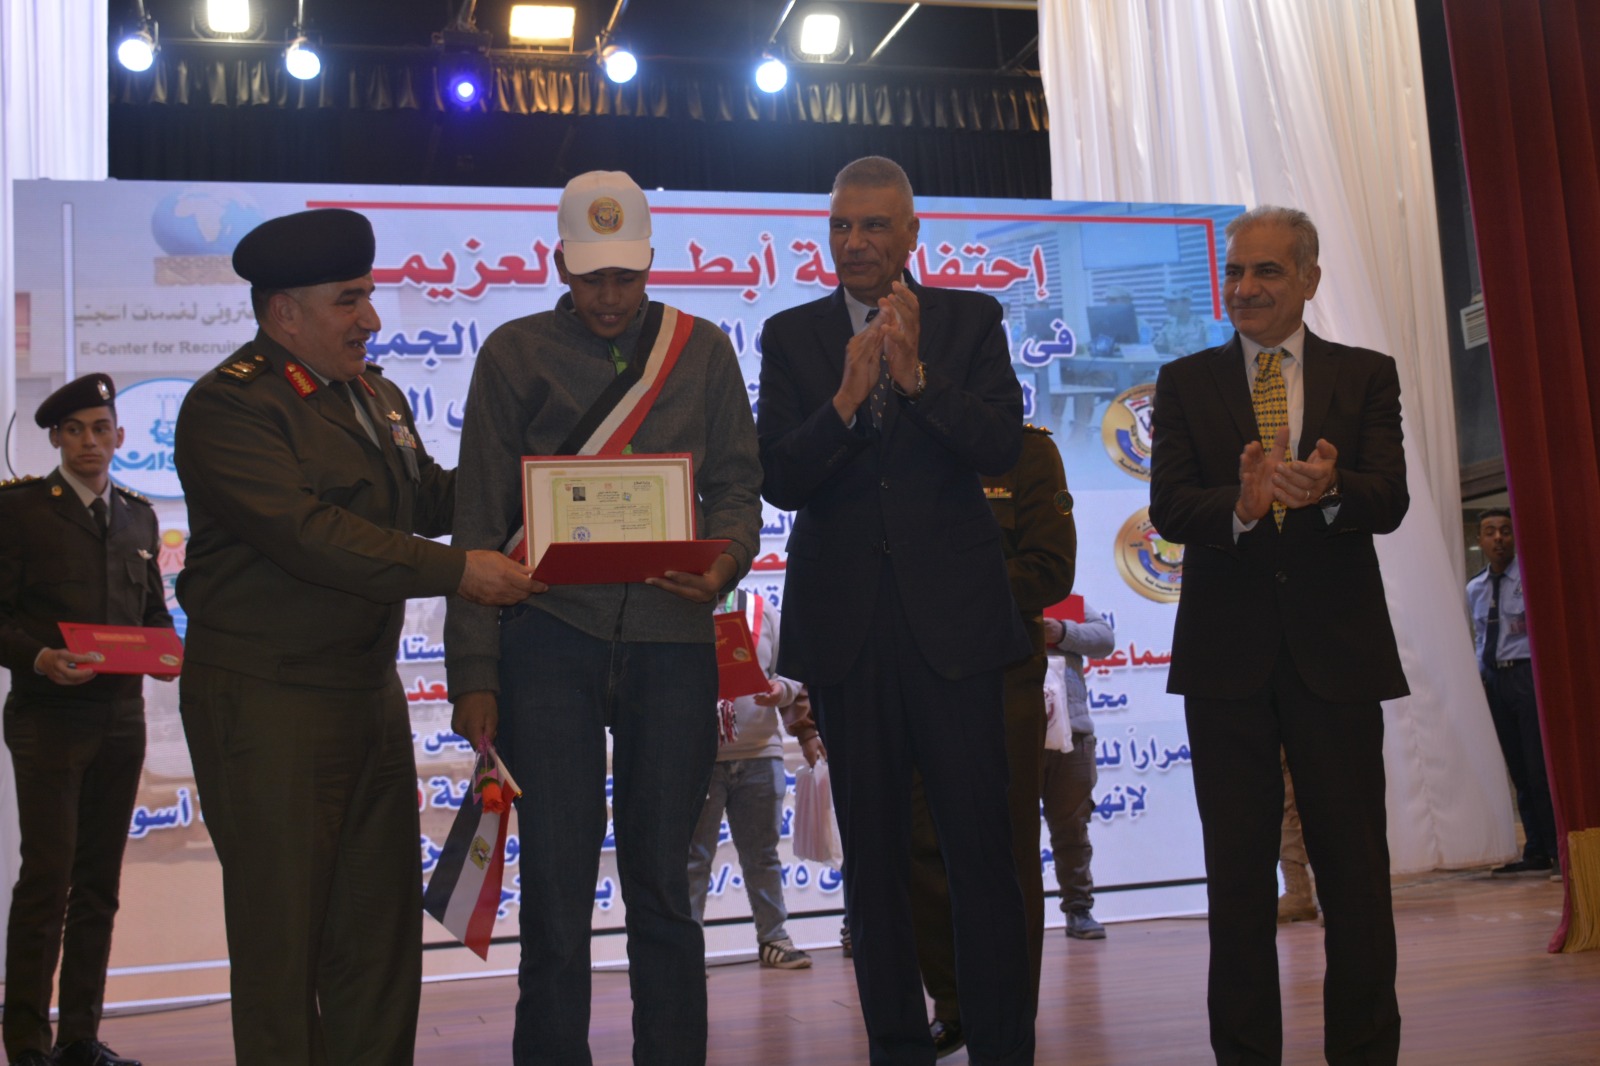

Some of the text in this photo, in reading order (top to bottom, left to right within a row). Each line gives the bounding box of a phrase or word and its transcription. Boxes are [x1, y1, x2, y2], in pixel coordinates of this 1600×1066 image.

[79, 341, 148, 355] E-Center
[153, 341, 175, 354] for
[1022, 320, 1073, 364] فى
